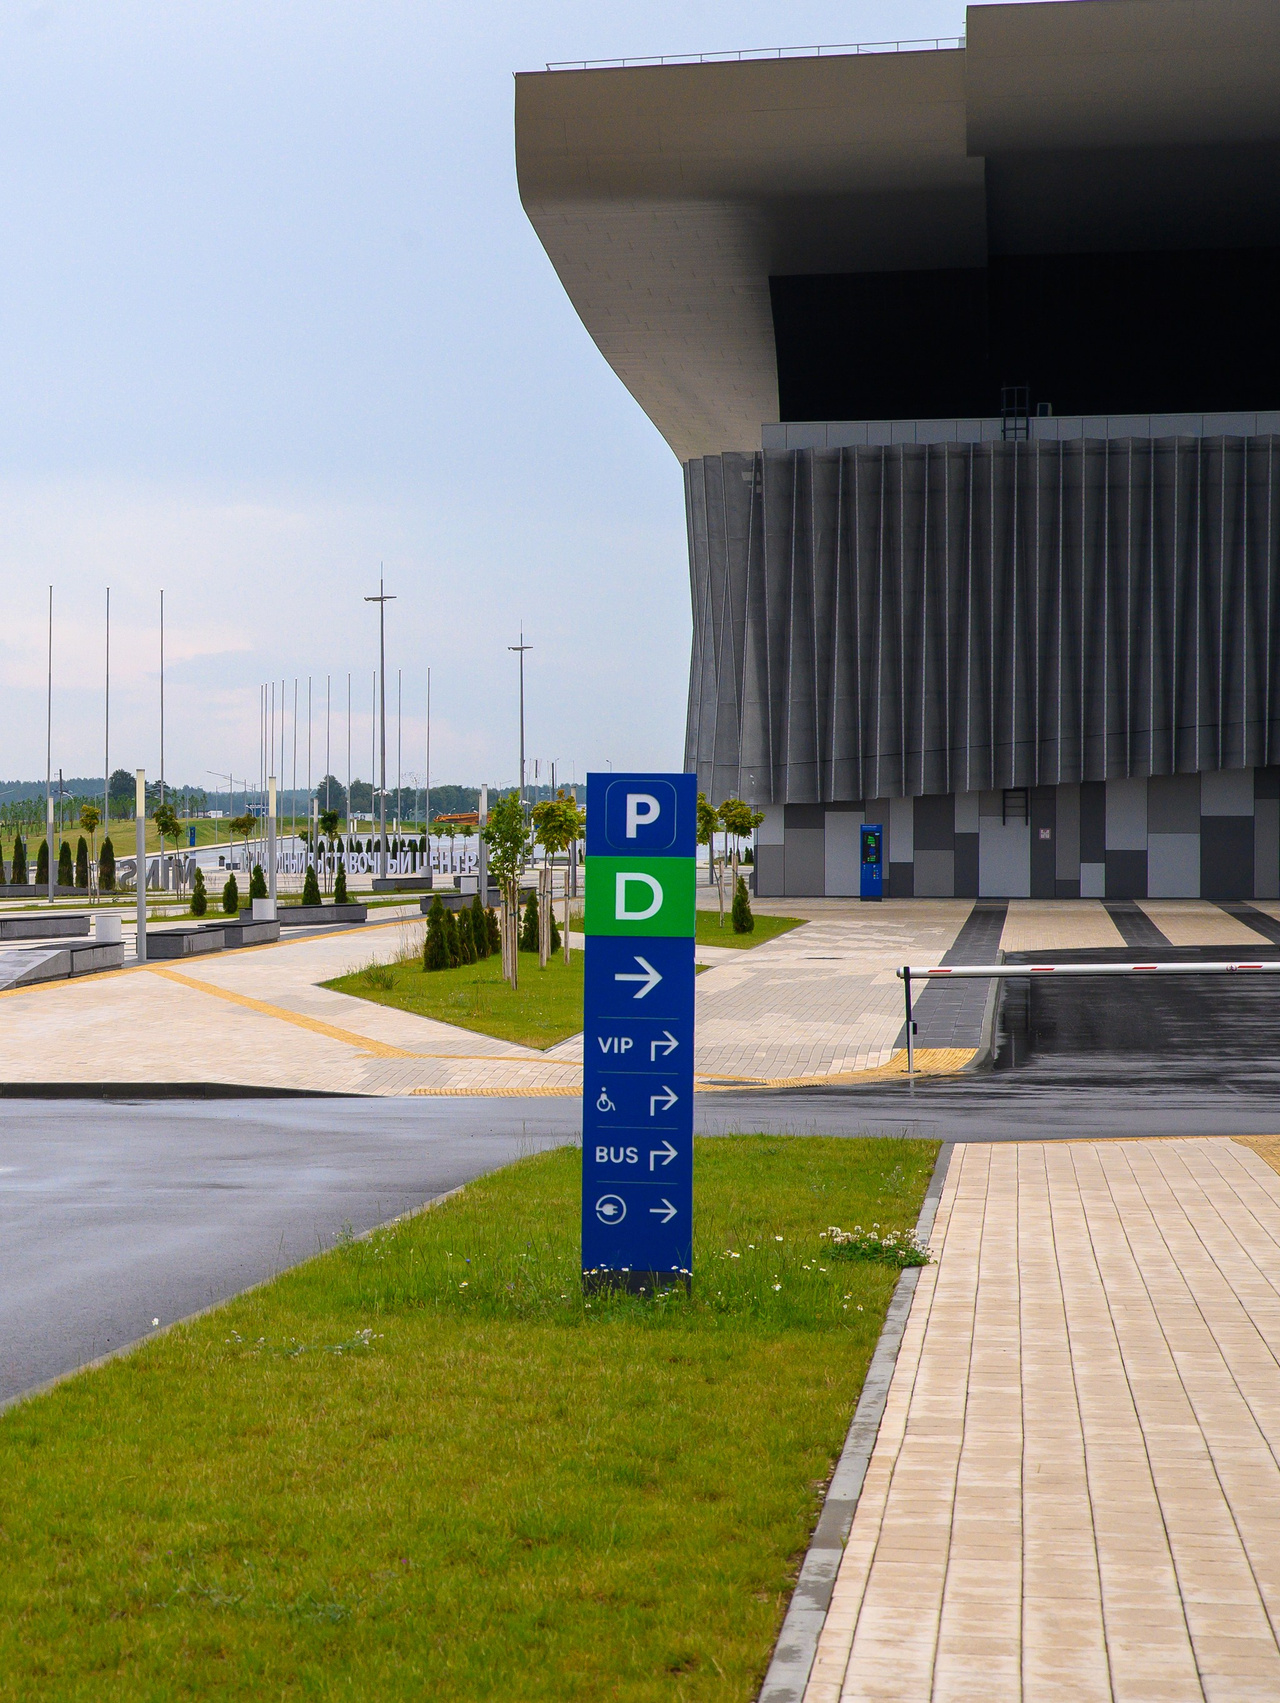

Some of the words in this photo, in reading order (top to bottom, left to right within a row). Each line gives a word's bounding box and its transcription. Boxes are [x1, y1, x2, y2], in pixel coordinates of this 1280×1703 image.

[627, 793, 660, 838] P
[616, 872, 664, 920] D
[598, 1037, 633, 1054] VIP
[595, 1146, 638, 1164] BUS
